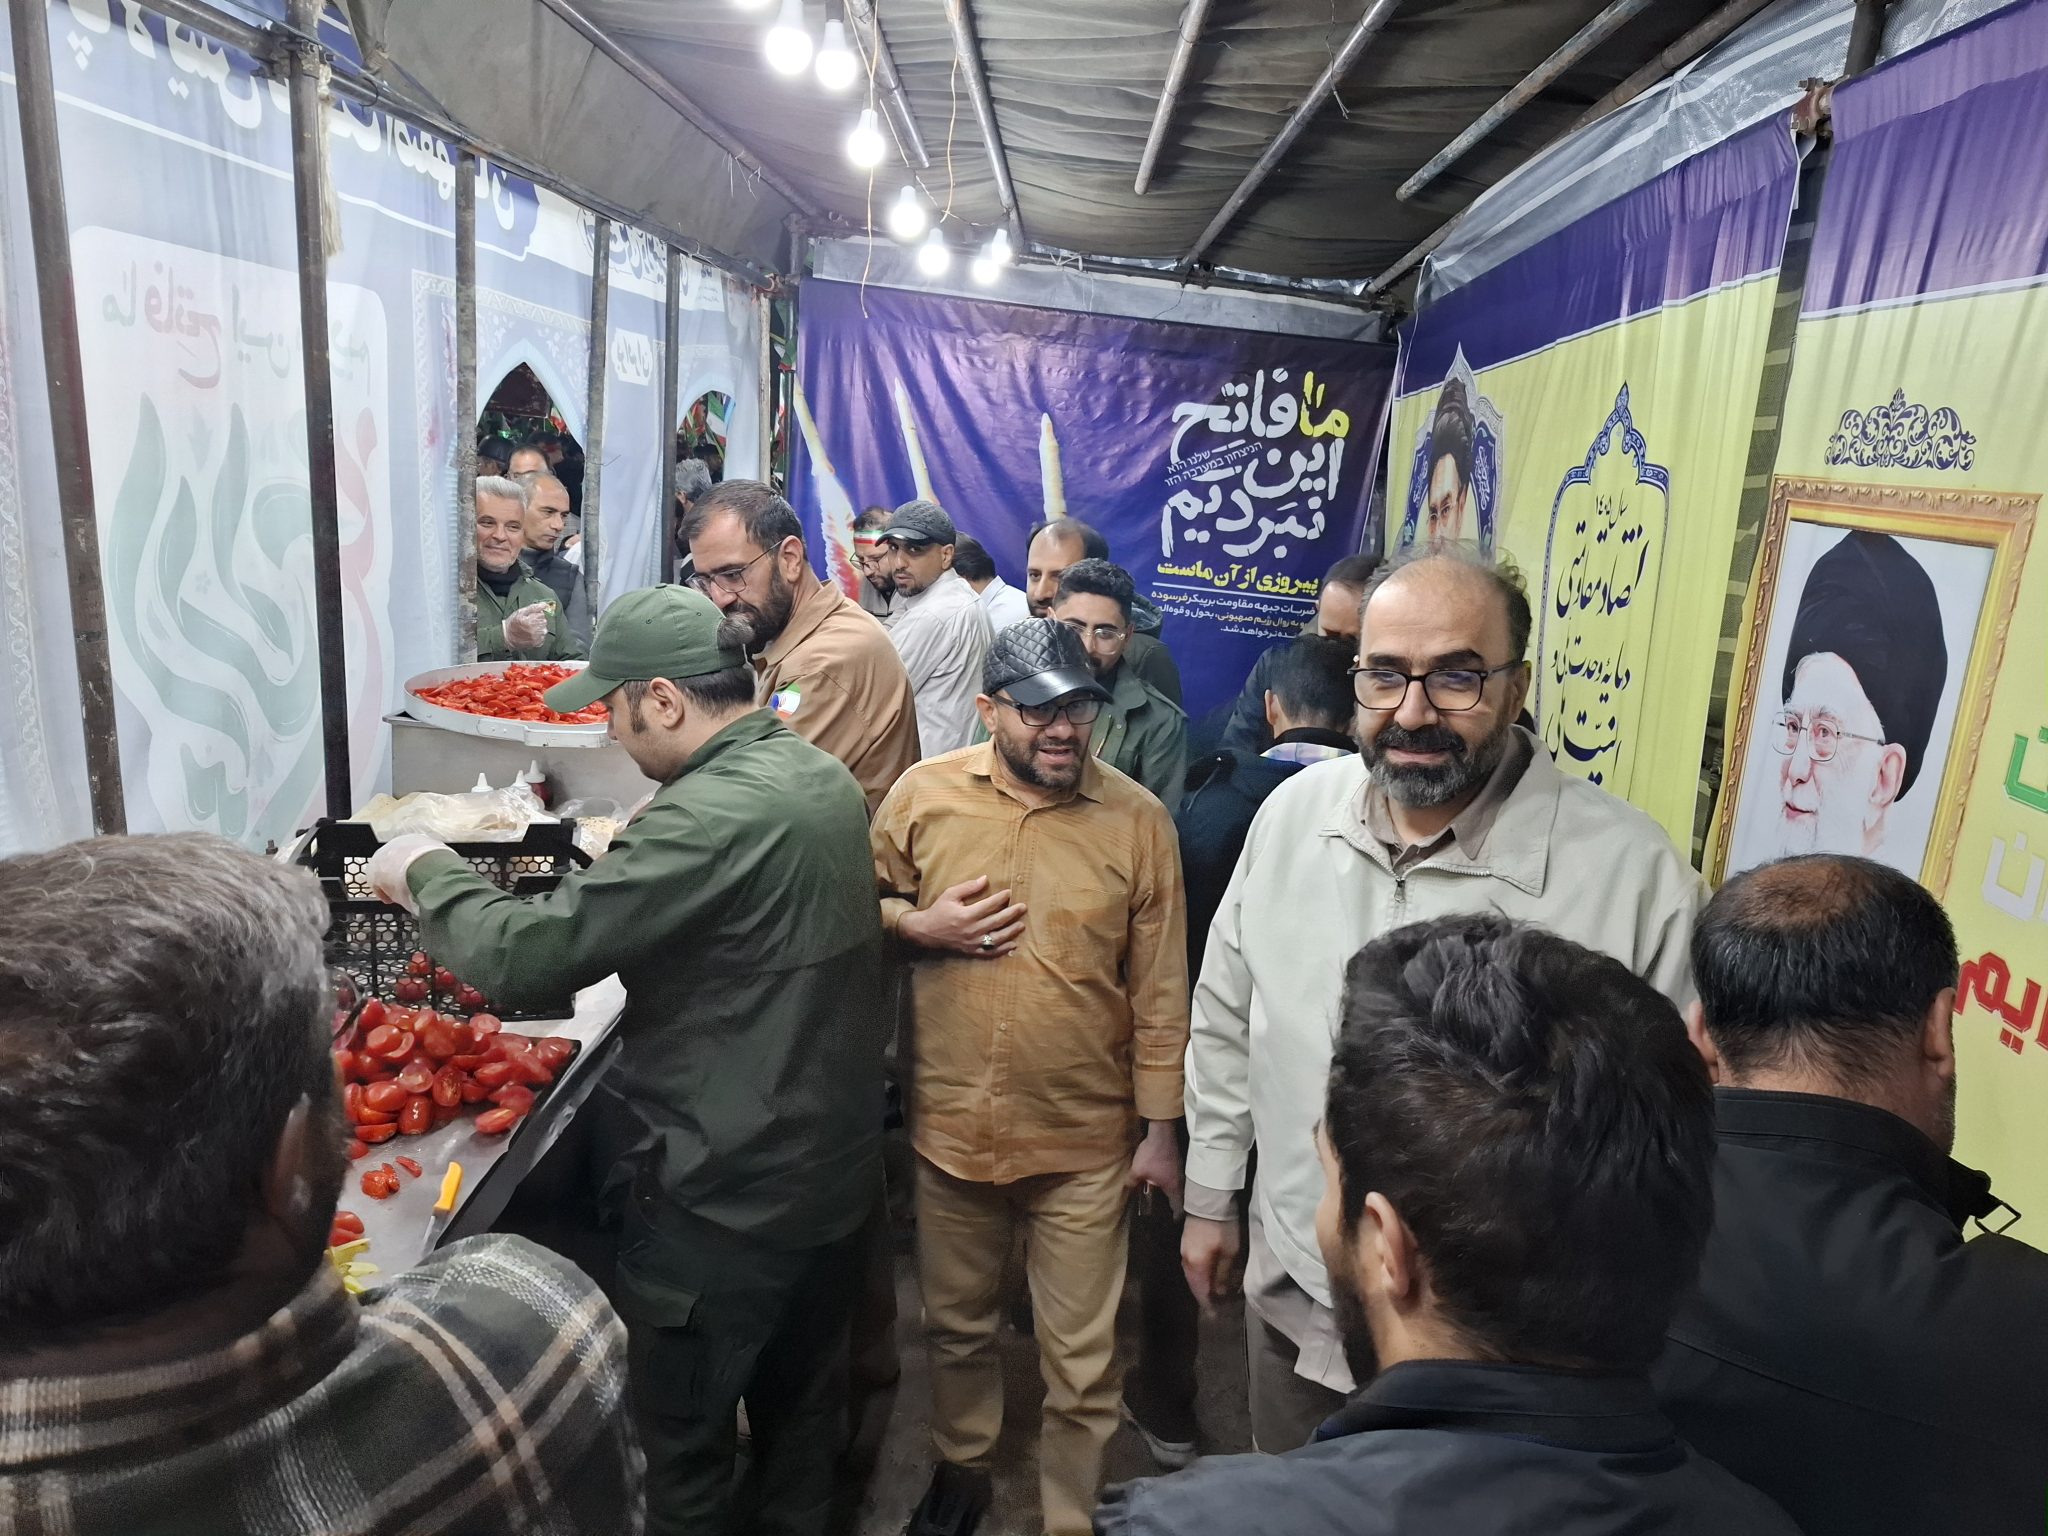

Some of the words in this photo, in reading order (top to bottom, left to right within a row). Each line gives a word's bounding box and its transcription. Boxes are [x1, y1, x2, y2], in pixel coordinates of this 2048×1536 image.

[1299, 370, 1350, 438] ما
[1170, 367, 1299, 482] فاتح
[1188, 450, 1211, 466] שלנו
[1225, 441, 1263, 464] הניצחון
[1166, 459, 1187, 475] הוא
[1182, 458, 1225, 480] במערכה
[1242, 437, 1346, 500] این
[1164, 474, 1182, 487] הזו
[1608, 488, 1629, 530] سال
[1160, 484, 1326, 558] نبردیم
[1157, 560, 1213, 581] ماست
[1213, 564, 1242, 587] آن
[1237, 566, 1257, 589] از
[1596, 524, 1650, 617] اقتصاد
[1256, 572, 1319, 596] پیروزی
[1151, 591, 1188, 604] فرسوده
[1216, 597, 1254, 610] مقاومت
[1254, 601, 1281, 615] جبهه
[1280, 603, 1316, 617] ضربات
